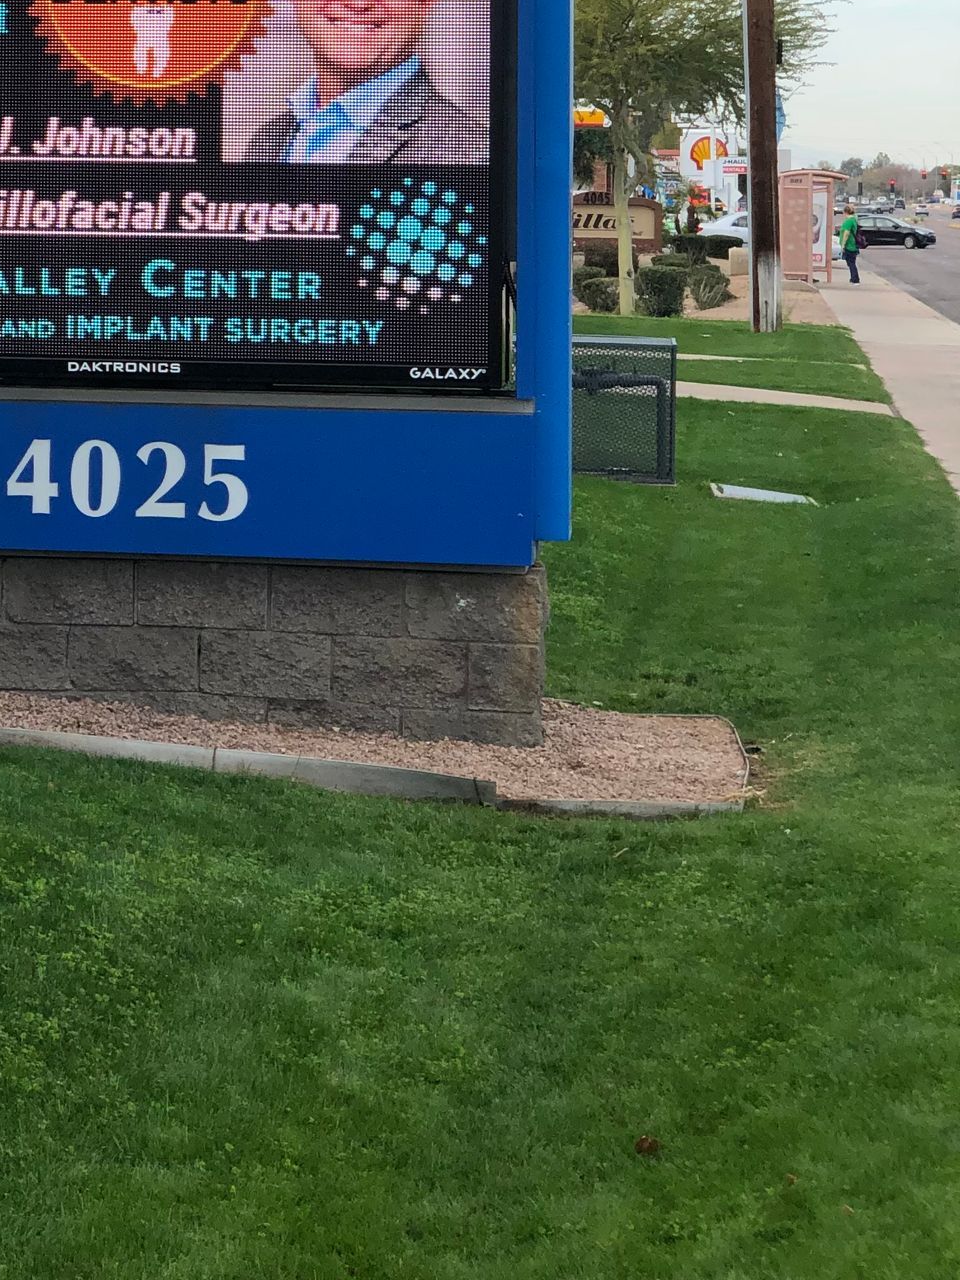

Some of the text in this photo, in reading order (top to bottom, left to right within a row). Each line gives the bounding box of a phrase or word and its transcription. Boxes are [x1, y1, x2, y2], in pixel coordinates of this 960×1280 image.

[32, 117, 197, 156] Johnson
[178, 191, 340, 241] Surgeon
[573, 211, 635, 229] illa
[141, 258, 322, 300] CENTER
[67, 314, 214, 342] IMPLANT
[224, 317, 385, 346] SURGERY
[67, 361, 181, 373] DAKTRONICS
[6, 438, 249, 522] 4025
